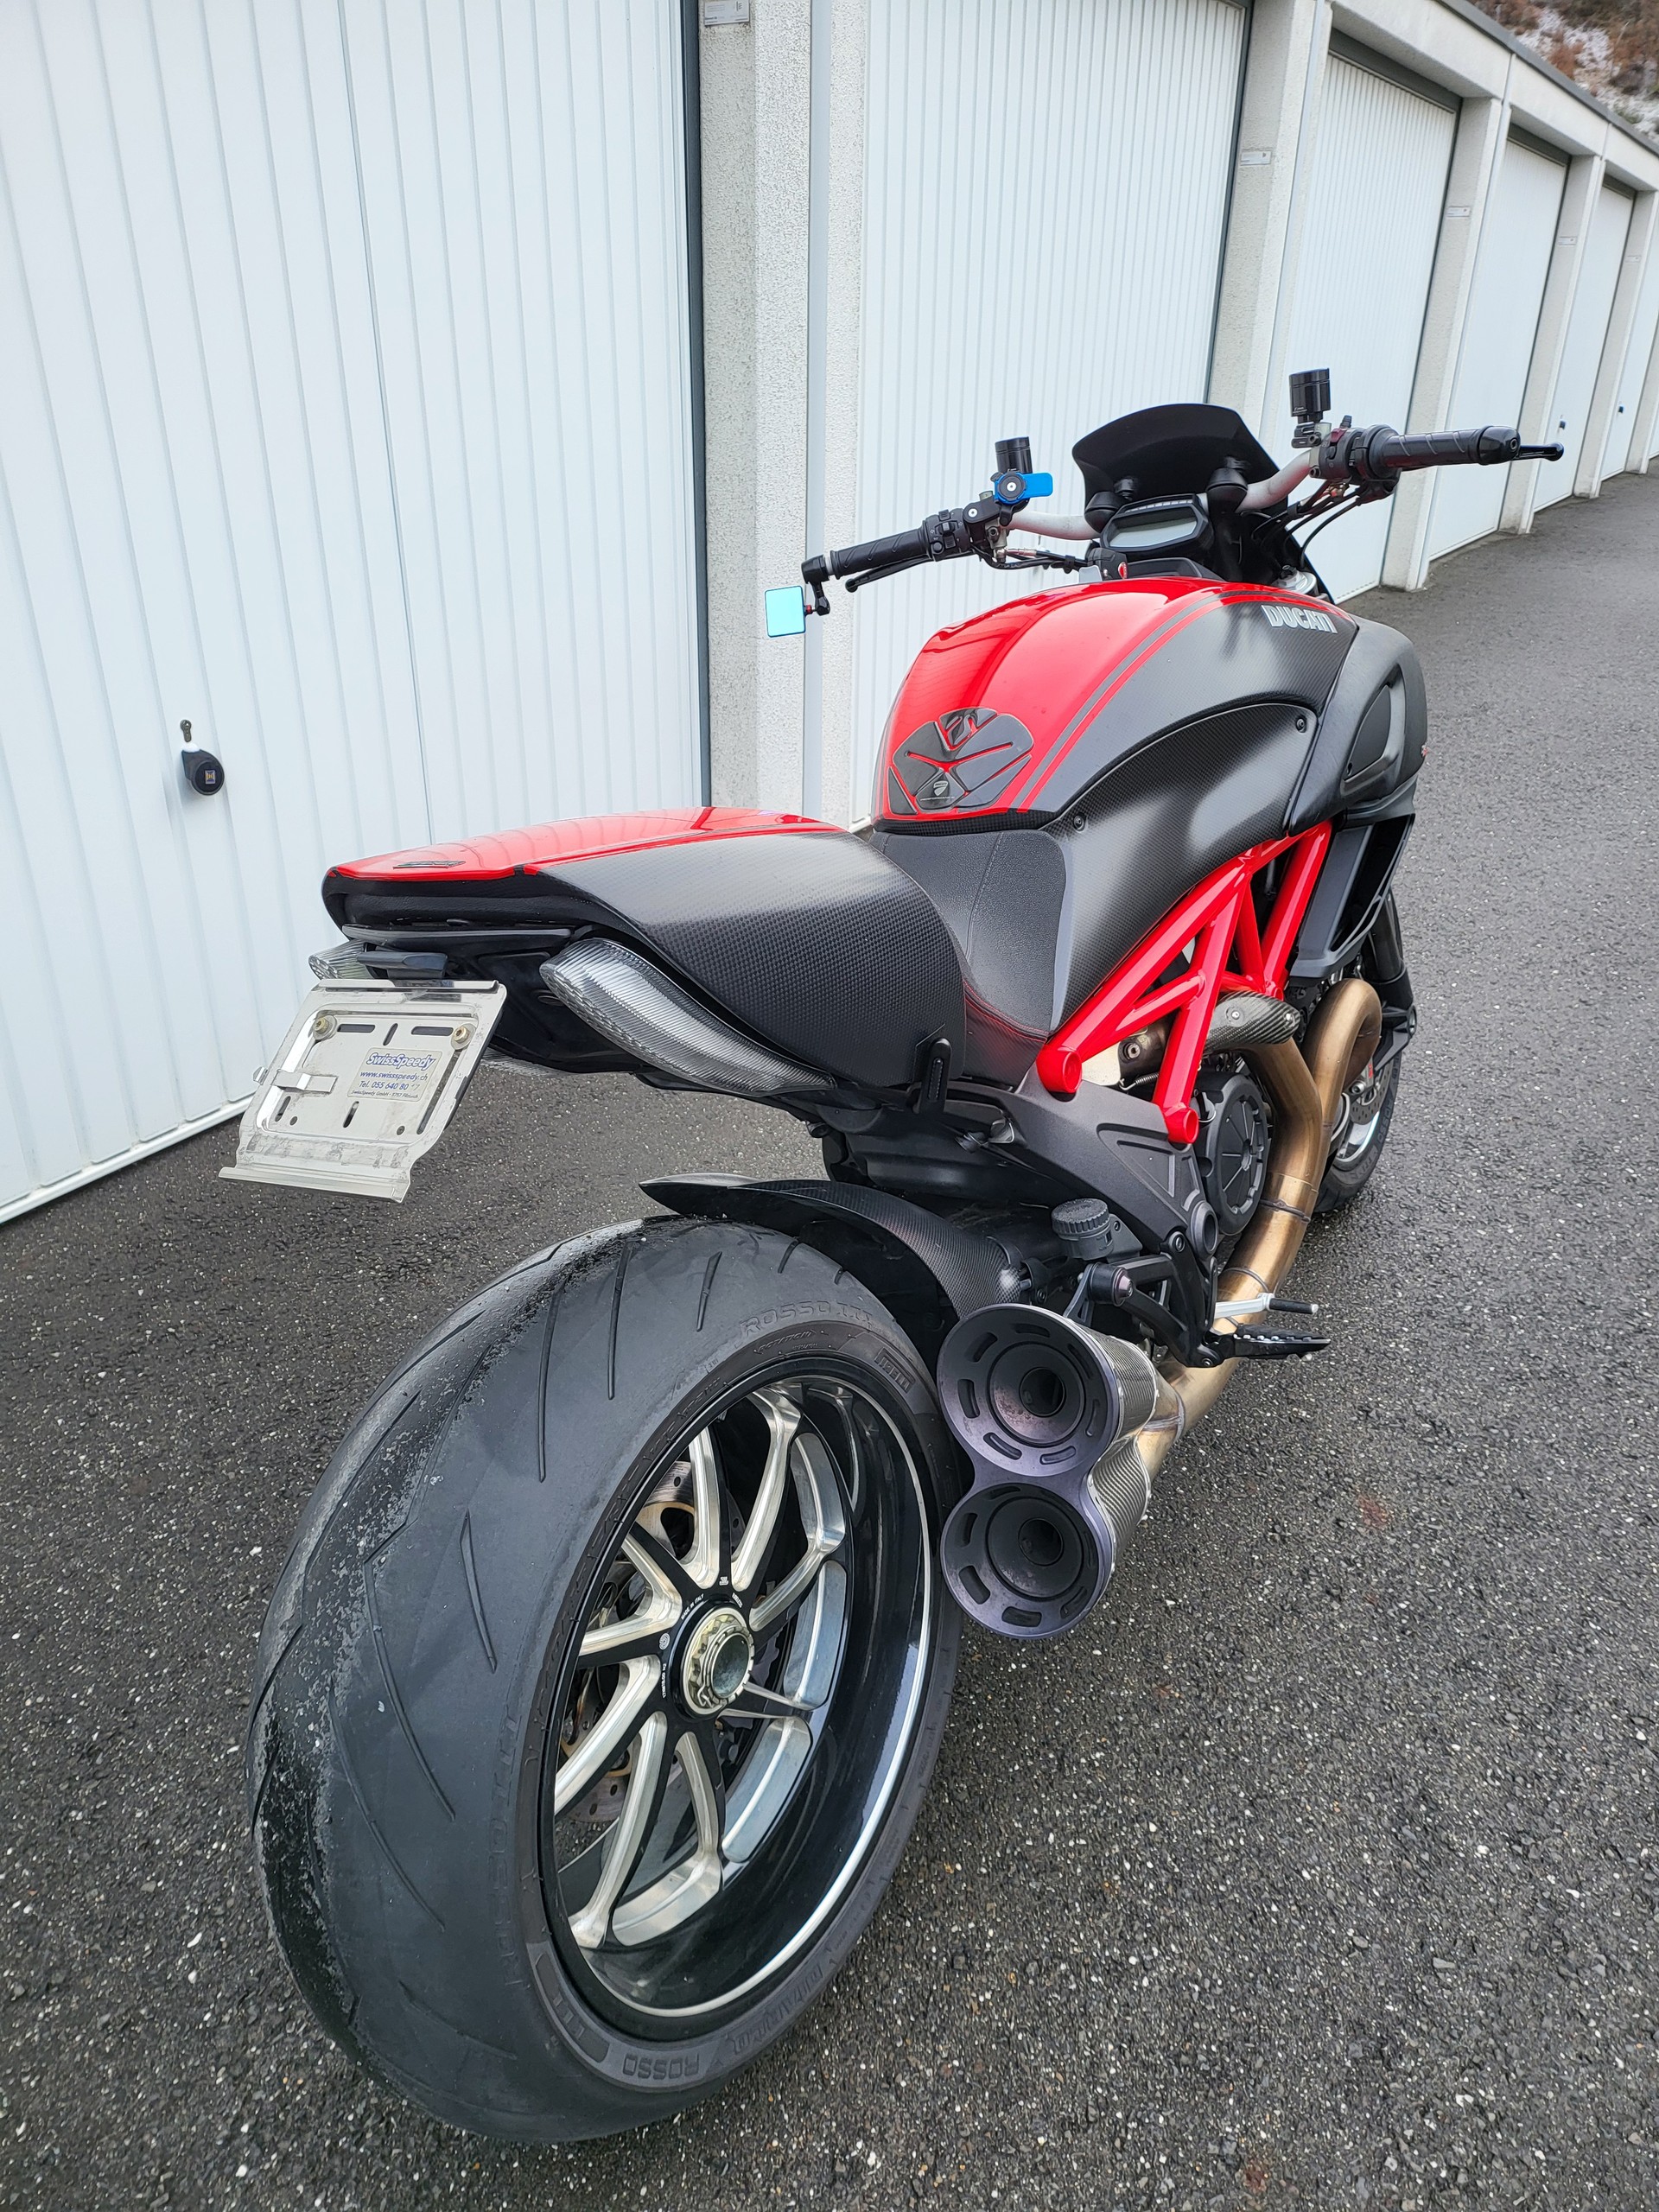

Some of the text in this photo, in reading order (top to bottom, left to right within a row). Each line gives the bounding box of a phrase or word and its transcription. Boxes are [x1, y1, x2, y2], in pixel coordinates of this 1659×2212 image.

[1261, 604, 1338, 634] DUCATI
[366, 1052, 436, 1071] SwissSpeedy
[359, 1071, 429, 1082] www.swissspeedy.ch
[740, 1300, 832, 1338] ROSSO
[622, 2052, 701, 2080] ROSSO
